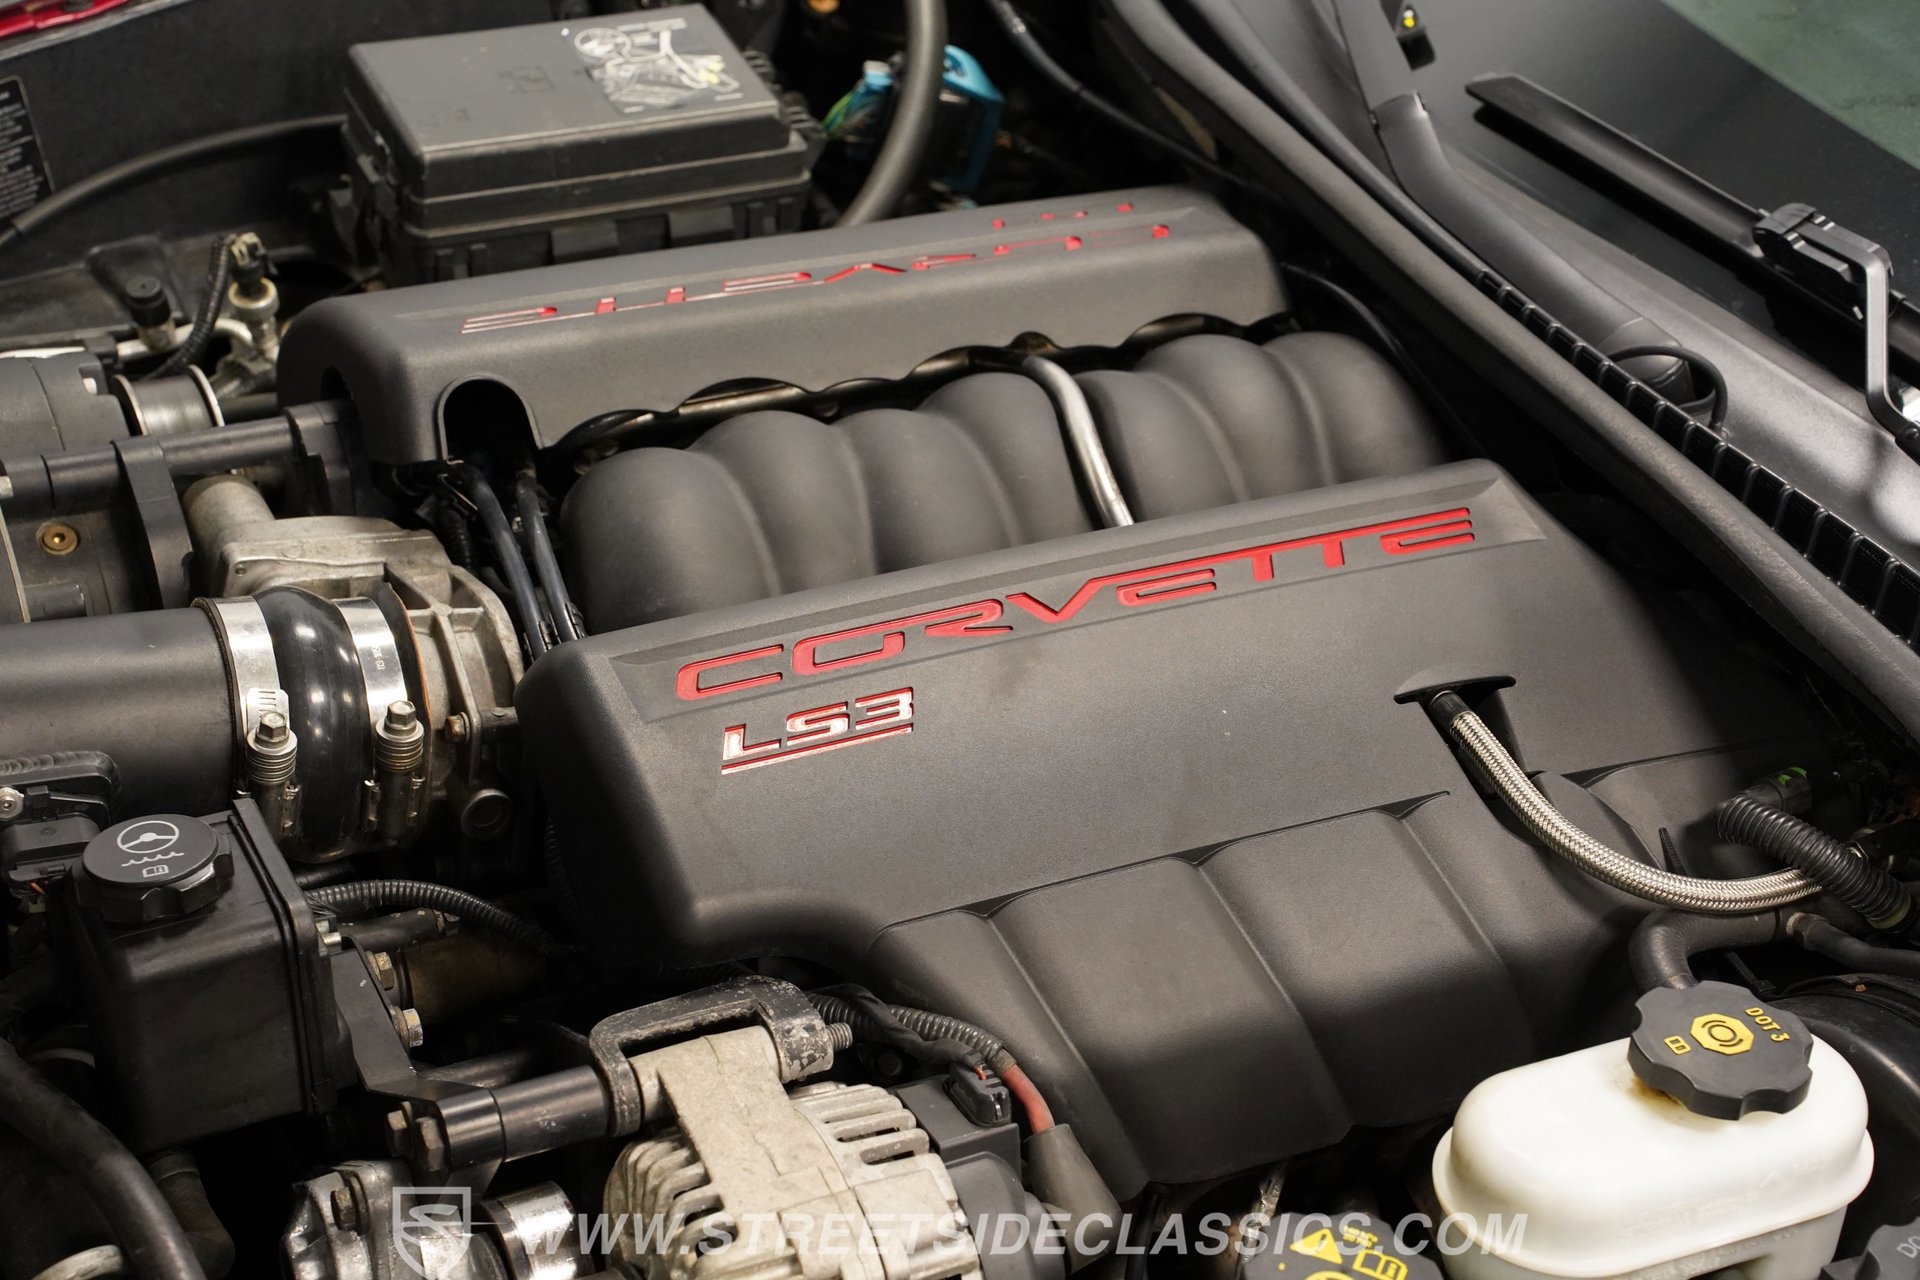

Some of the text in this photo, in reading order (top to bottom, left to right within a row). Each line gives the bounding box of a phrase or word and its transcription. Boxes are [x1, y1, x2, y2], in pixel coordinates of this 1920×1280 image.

[675, 507, 1476, 701] CORVETTE
[722, 687, 914, 761] LS3
[1745, 1007, 1790, 1042] DOT 3
